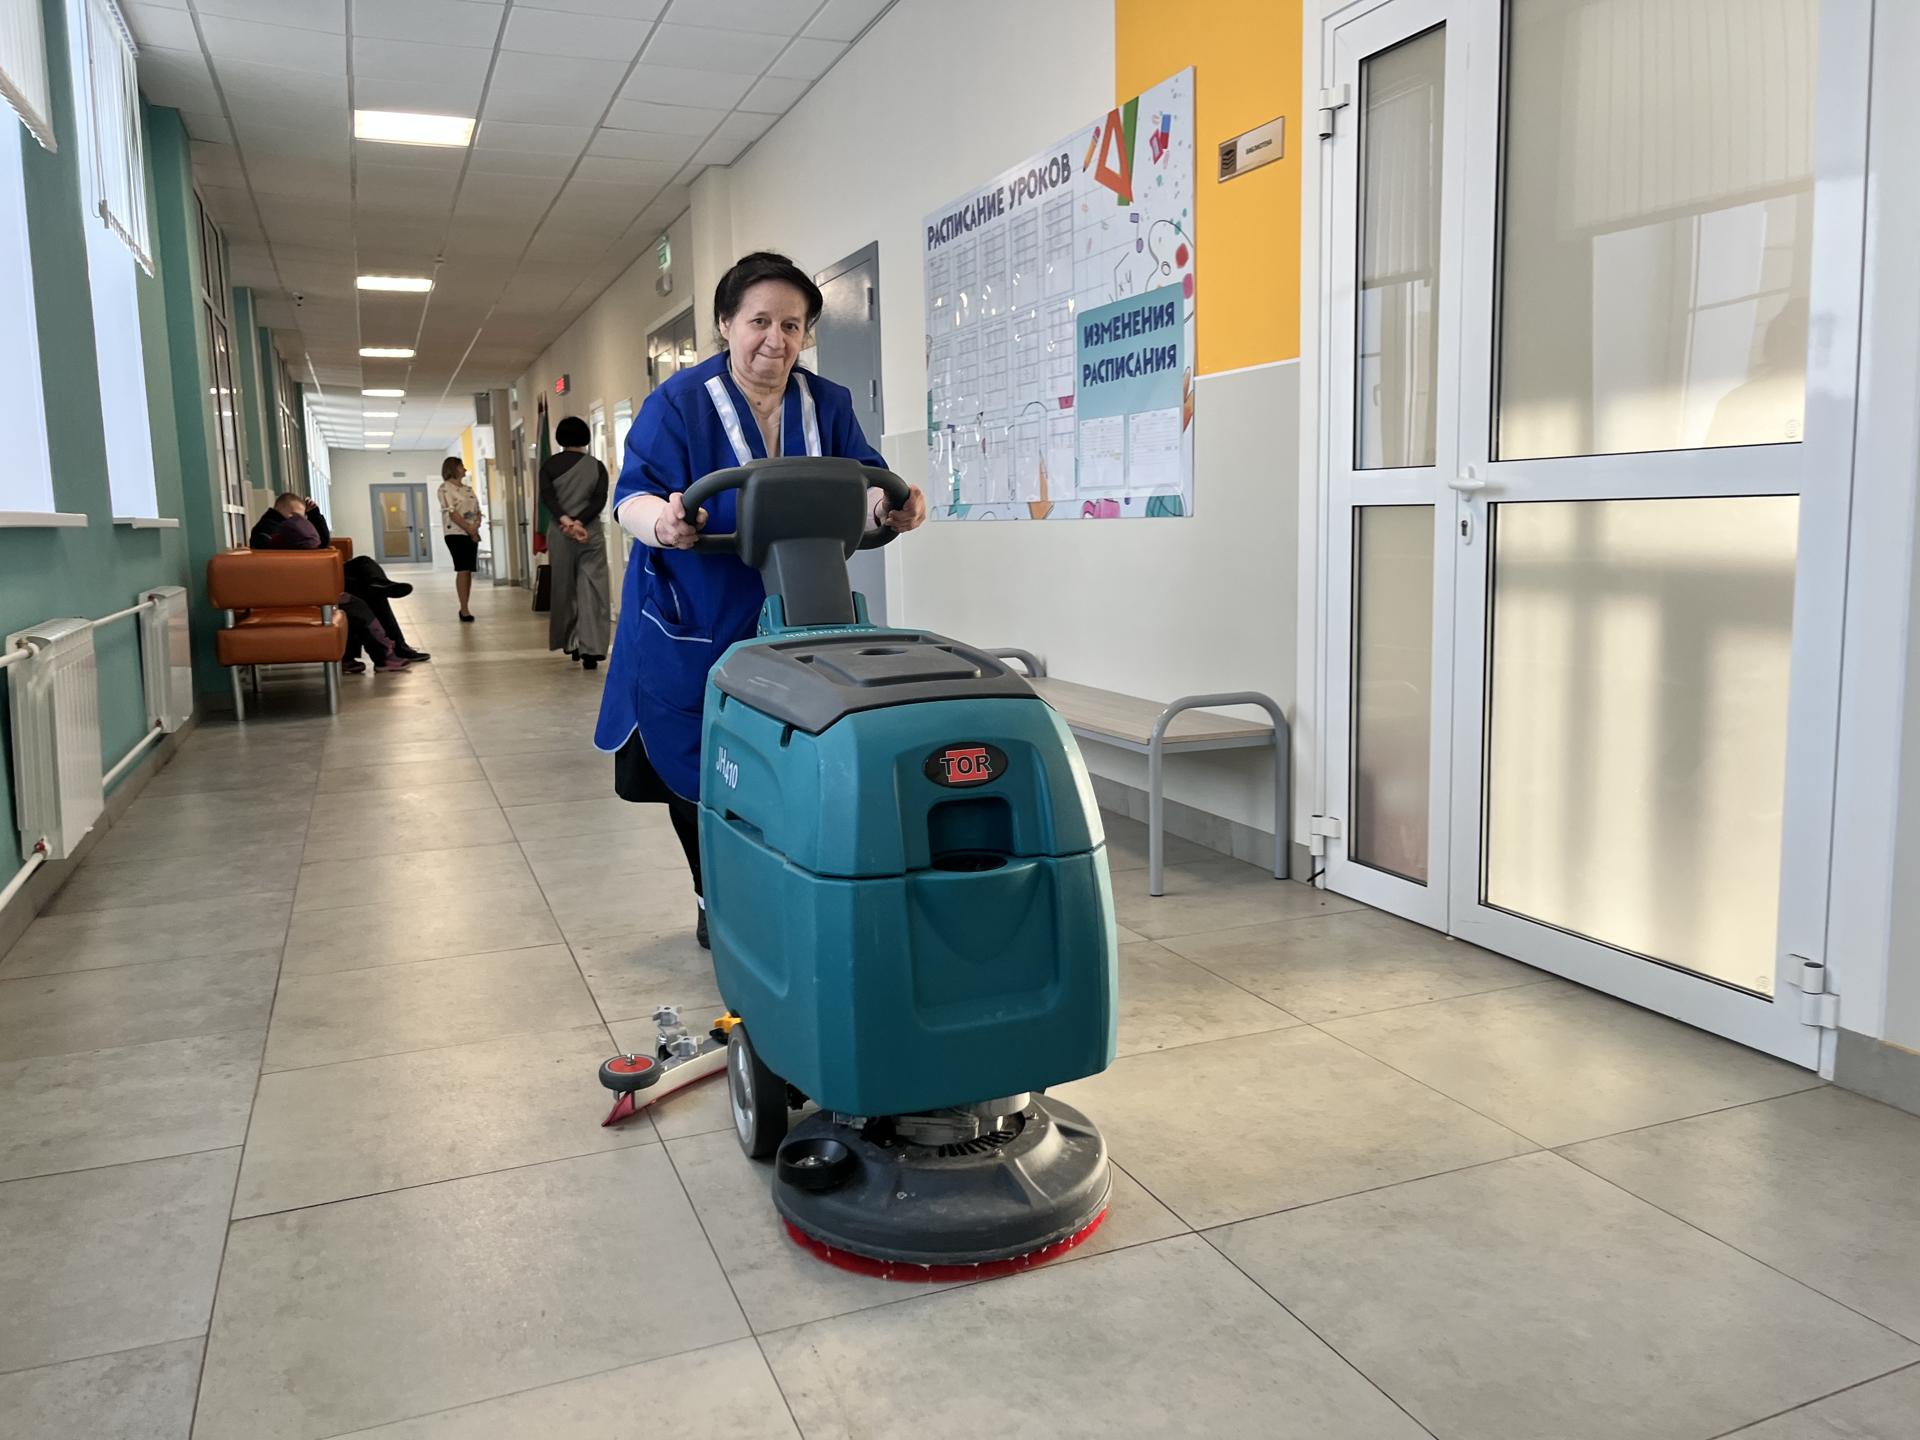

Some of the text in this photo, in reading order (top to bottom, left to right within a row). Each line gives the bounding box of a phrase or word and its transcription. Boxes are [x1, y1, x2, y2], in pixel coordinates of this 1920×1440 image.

[927, 187, 1005, 251] РАСПИСАНИЕ
[1009, 153, 1072, 210] УРОКОВ
[1083, 301, 1175, 349] ИЗМЕНЕНИЯ
[1082, 344, 1177, 388] РАСПИСАНИЯ
[939, 754, 993, 777] TOR
